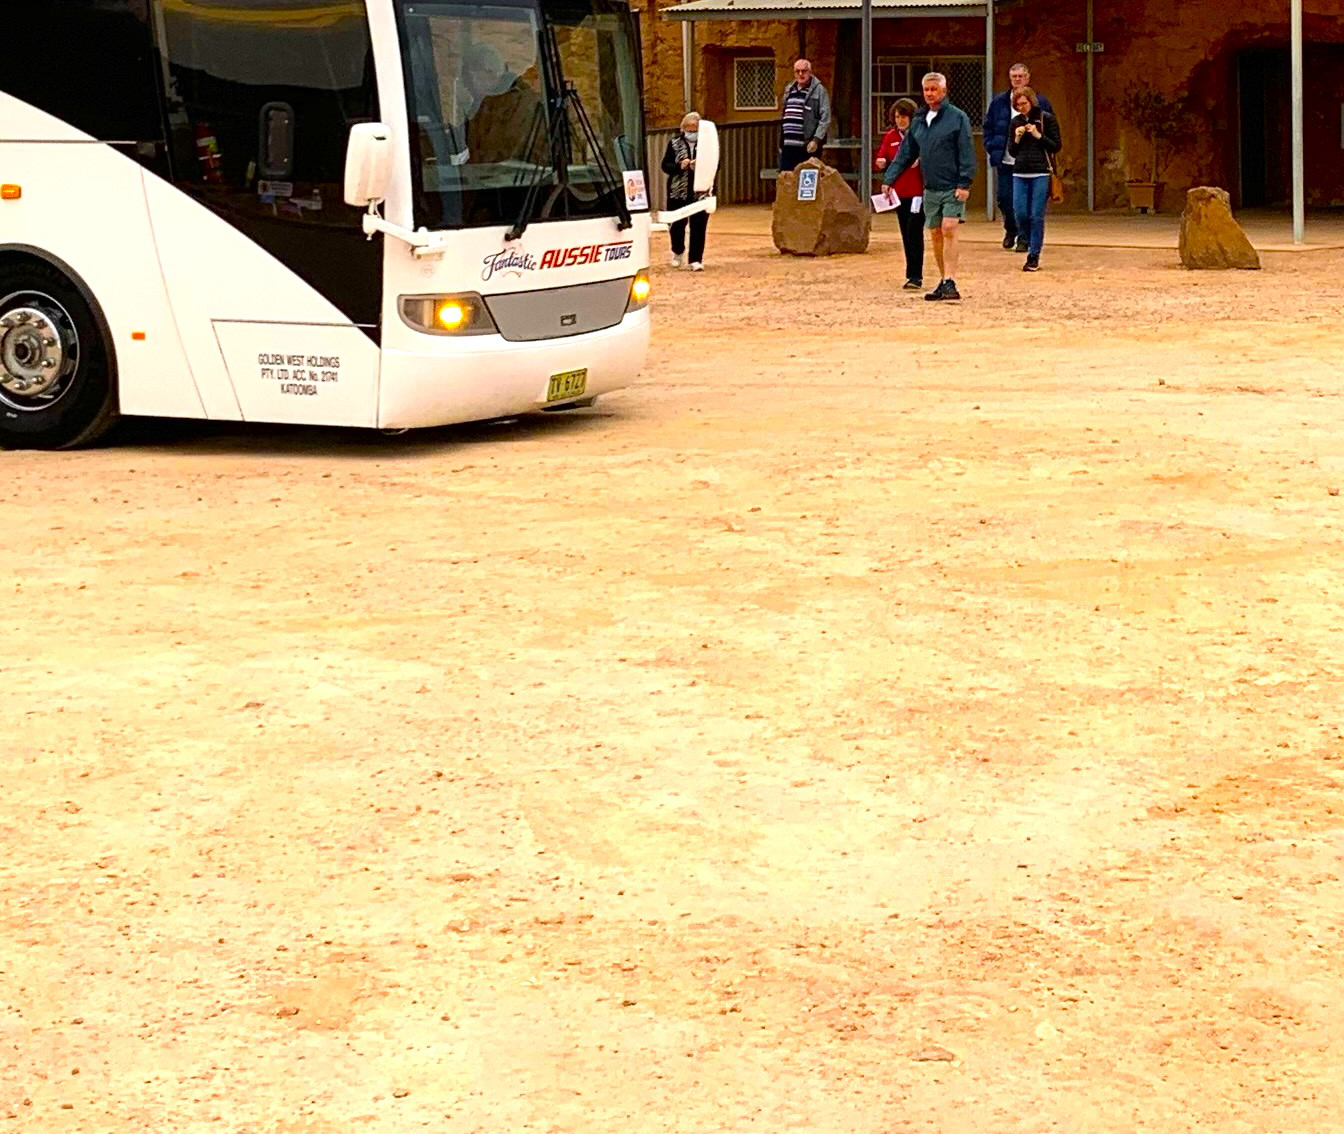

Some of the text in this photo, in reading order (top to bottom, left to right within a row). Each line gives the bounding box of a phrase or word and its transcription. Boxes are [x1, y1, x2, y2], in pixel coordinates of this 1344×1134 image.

[481, 243, 632, 281] Fantastic AUSSIE TOURS
[258, 353, 340, 368] GOLDEN WEST HOLDINGS
[281, 383, 318, 395] KATOOMBA
